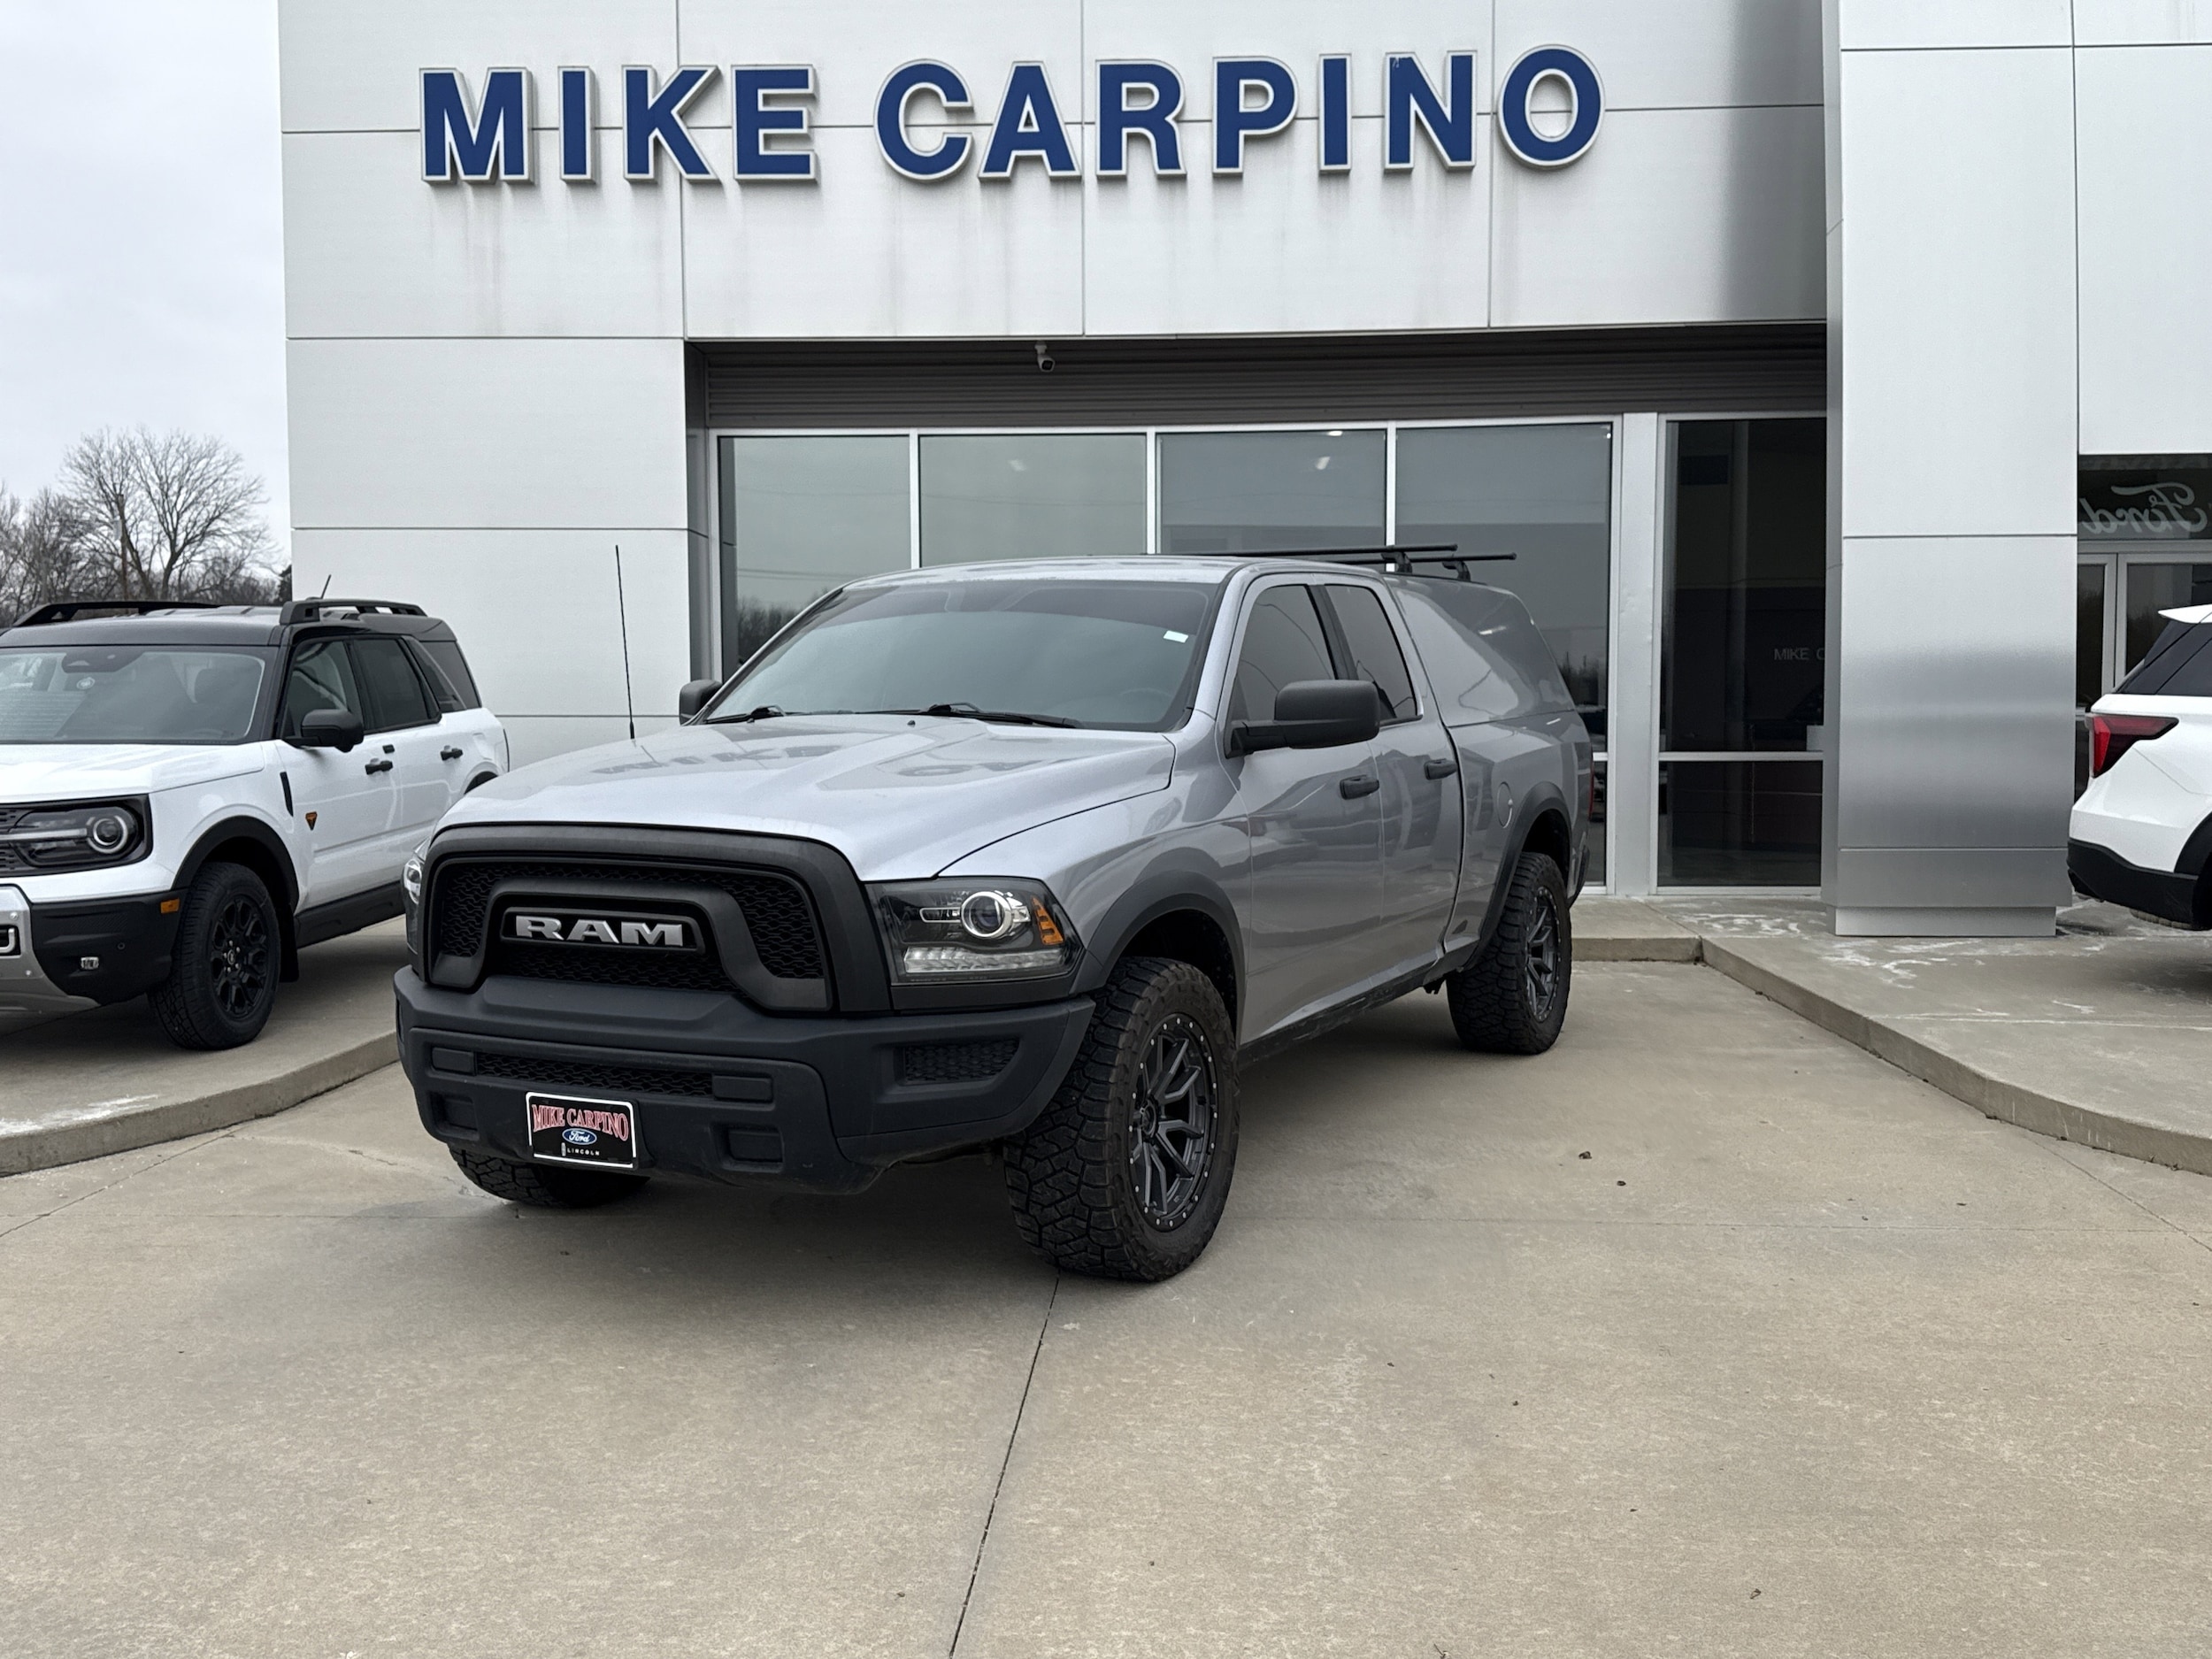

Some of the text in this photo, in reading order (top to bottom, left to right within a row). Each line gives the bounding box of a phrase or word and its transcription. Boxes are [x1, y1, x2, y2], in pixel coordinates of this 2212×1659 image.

[419, 44, 1605, 185] MIKE CARPINO
[1773, 647, 1810, 661] MIKE
[515, 915, 683, 947] RAM
[531, 1103, 629, 1141] MIKE CARPINO
[568, 1130, 591, 1142] Ford
[566, 1147, 600, 1156] LINCOLN
